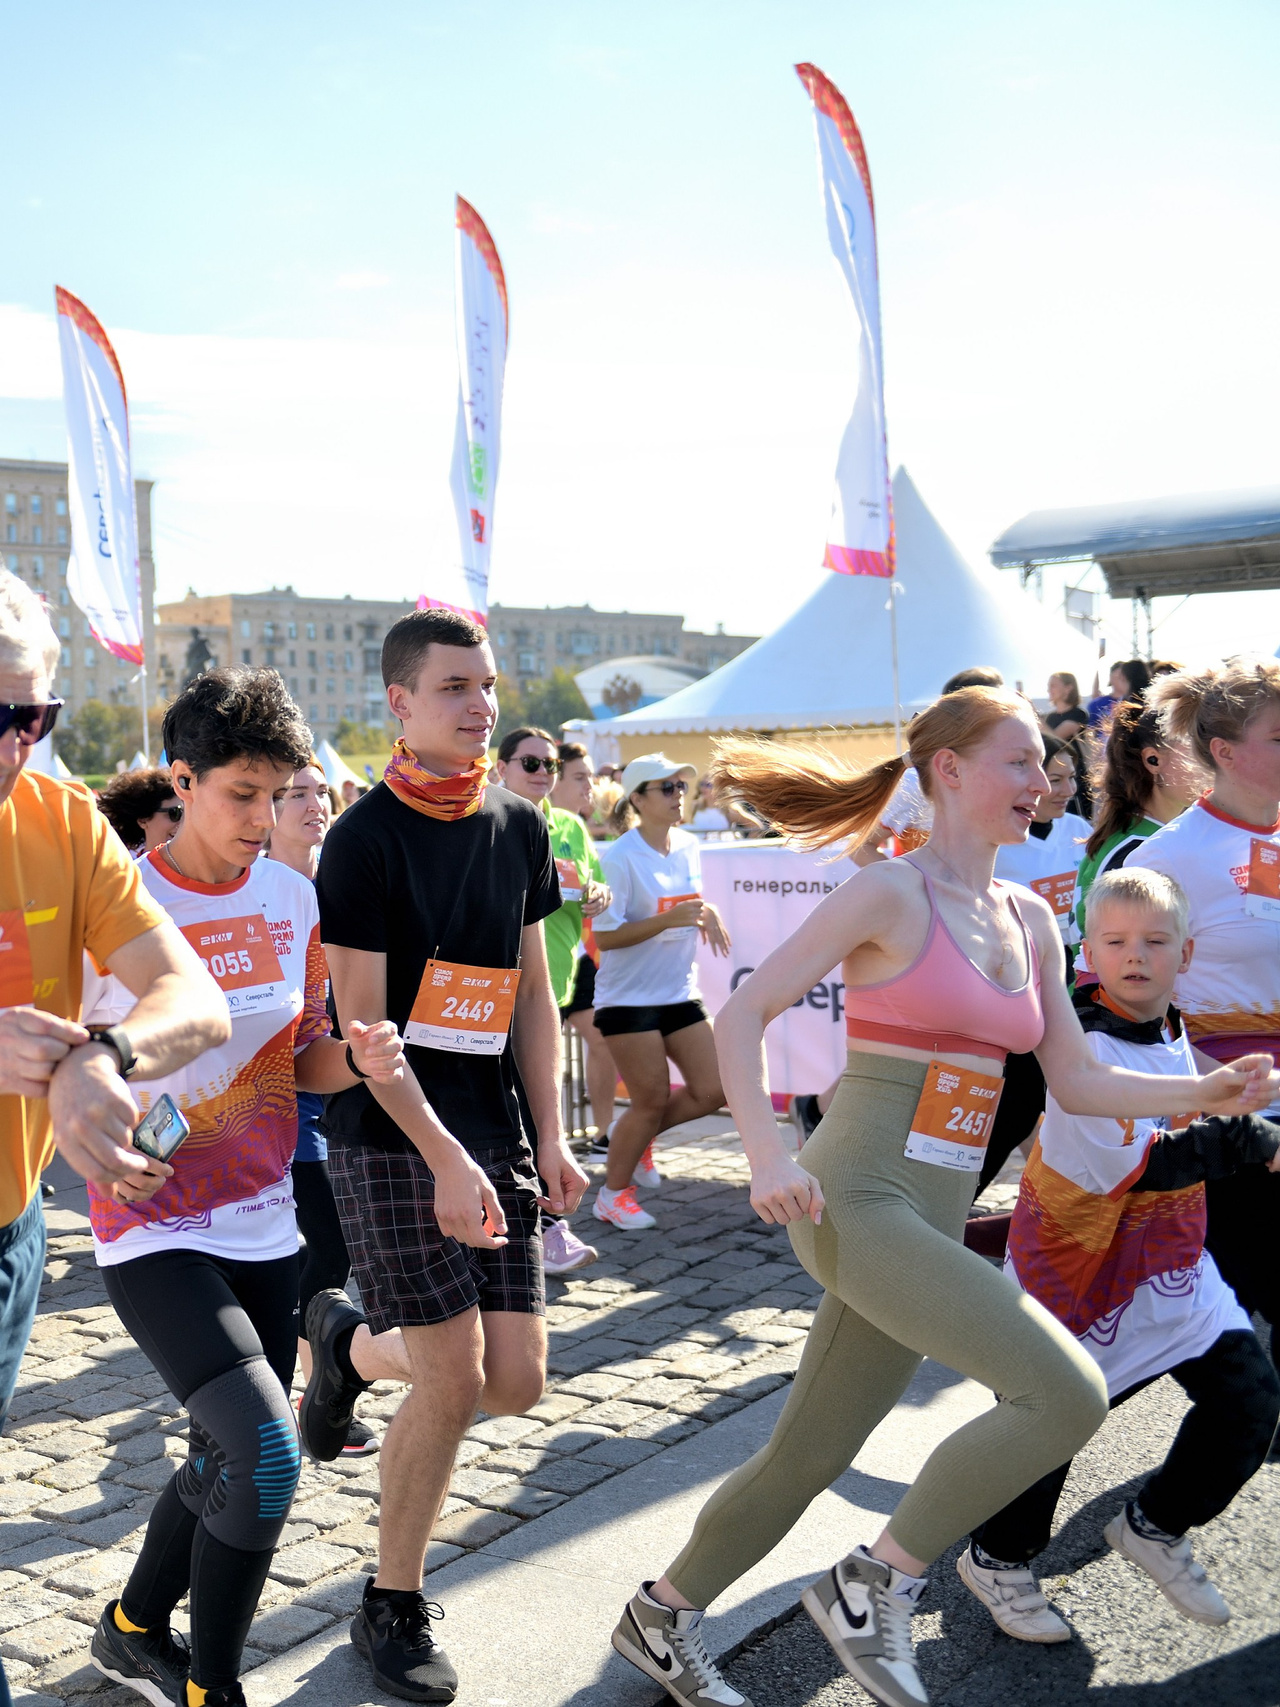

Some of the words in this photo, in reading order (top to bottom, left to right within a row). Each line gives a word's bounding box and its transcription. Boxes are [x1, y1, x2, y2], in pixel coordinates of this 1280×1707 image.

[266, 920, 293, 932] амое
[271, 930, 294, 945] ремя
[245, 991, 274, 1002] Северсталь
[440, 996, 495, 1023] 2449
[470, 1037, 494, 1046] Северсталь
[945, 1106, 993, 1137] 2451
